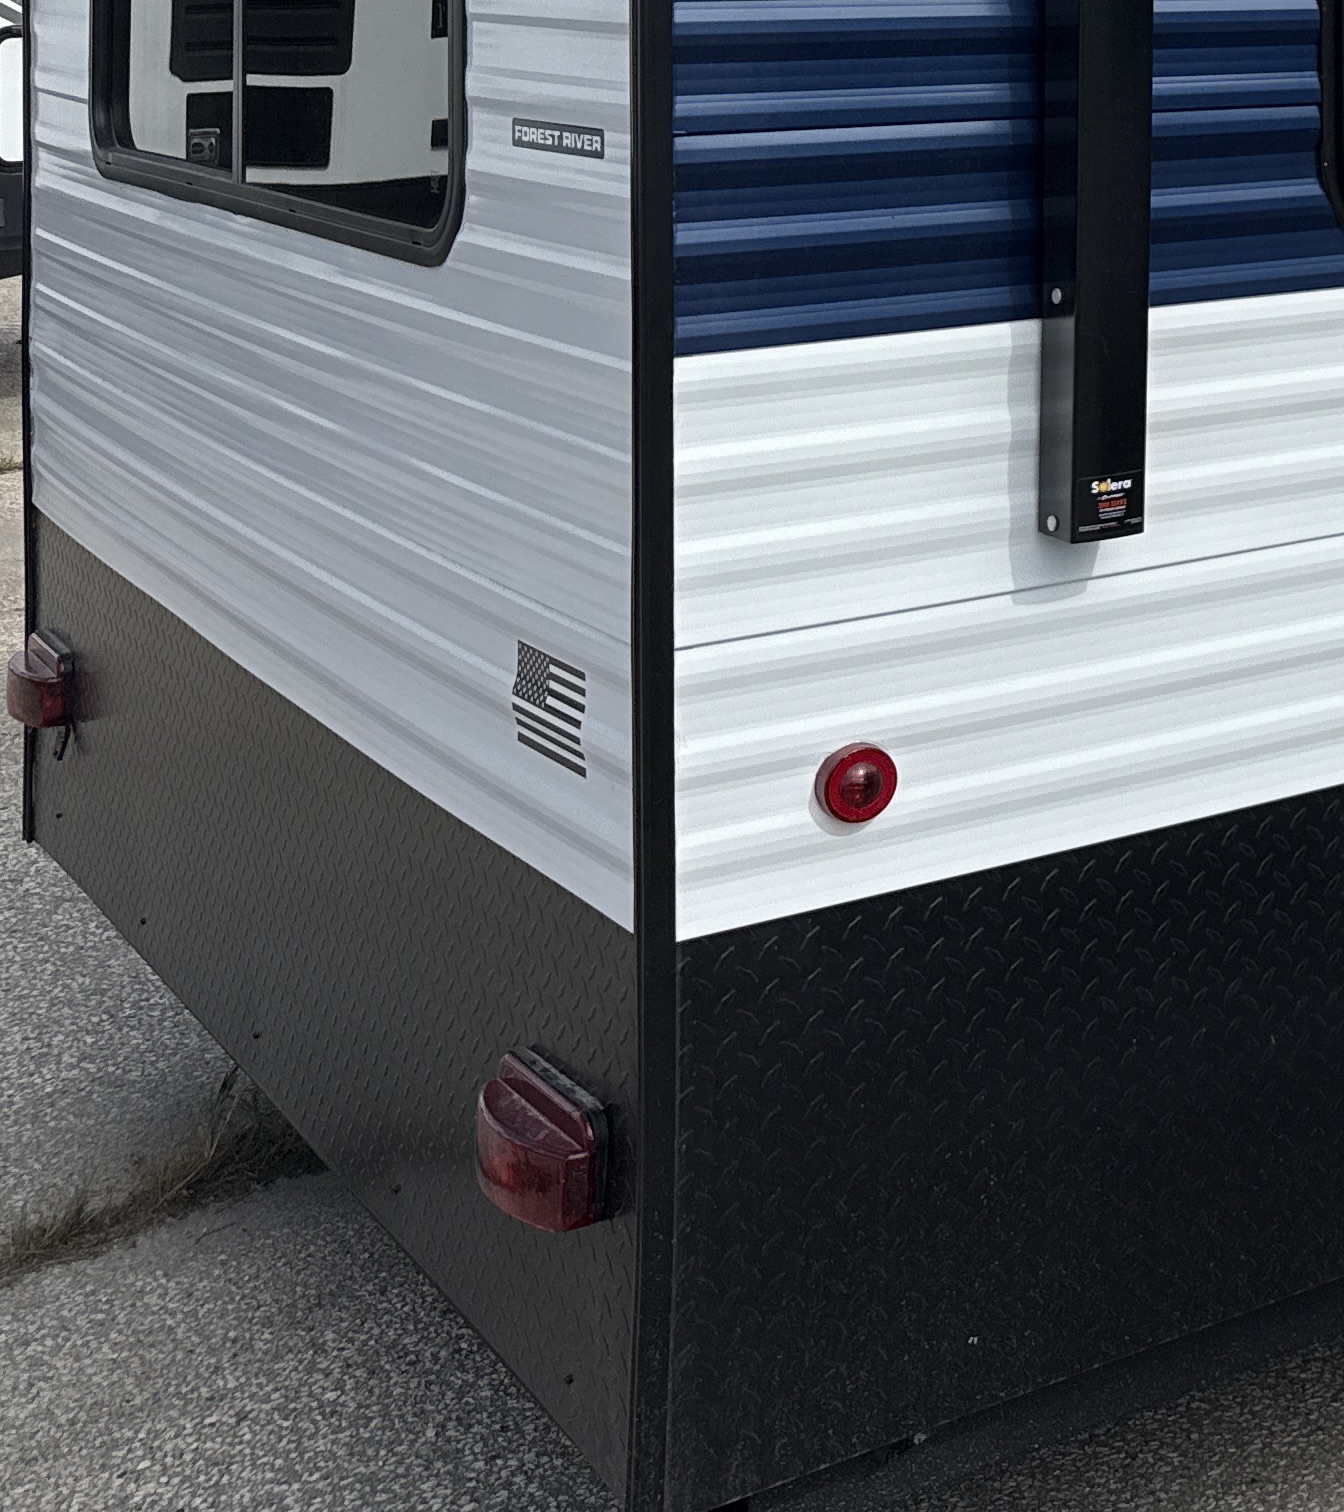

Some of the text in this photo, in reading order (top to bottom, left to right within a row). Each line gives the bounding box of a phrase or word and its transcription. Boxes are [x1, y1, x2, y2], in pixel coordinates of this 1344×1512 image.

[514, 125, 602, 152] FOREST RIVER
[1091, 478, 1132, 494] Solera
